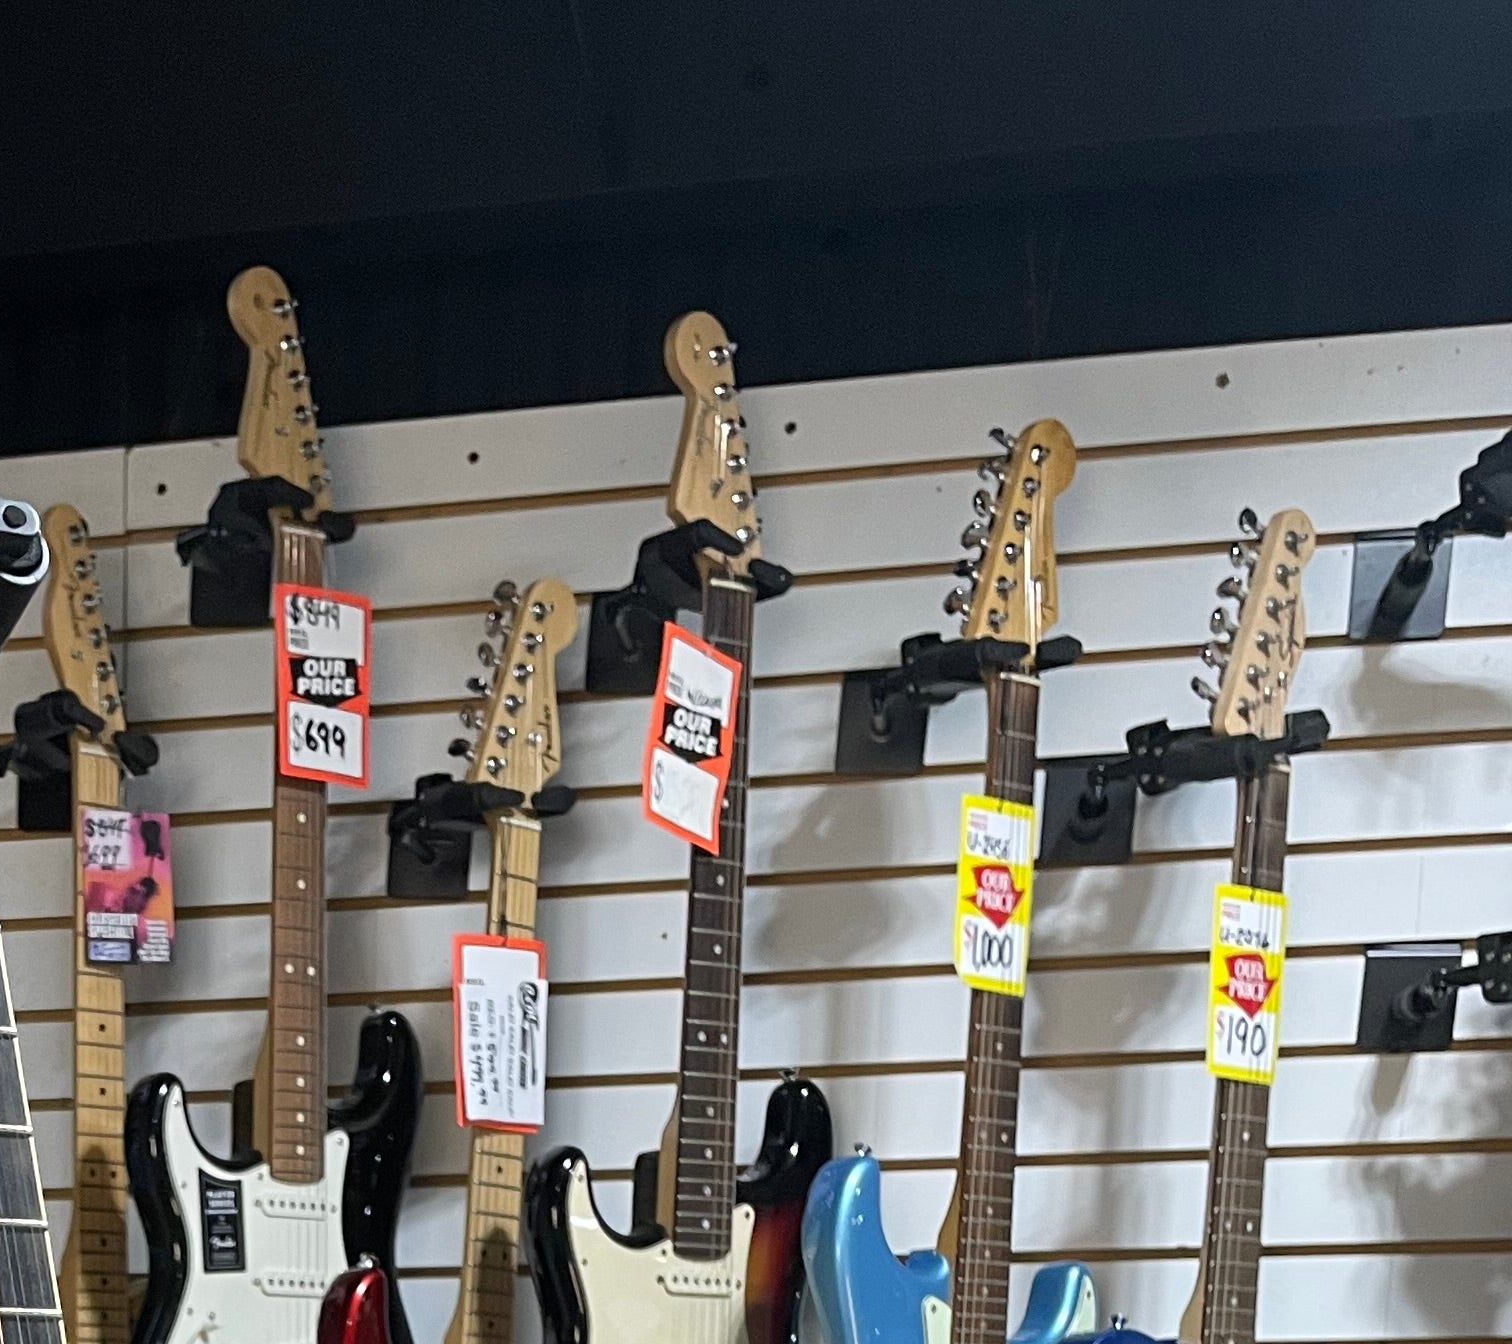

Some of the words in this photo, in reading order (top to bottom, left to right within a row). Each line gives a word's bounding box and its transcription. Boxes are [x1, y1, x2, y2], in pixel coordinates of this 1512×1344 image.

[303, 658, 347, 677] OUR
[297, 677, 356, 696] PRICE
[673, 707, 713, 735] OUR
[292, 711, 346, 761] $699
[664, 725, 719, 757] PRICE
[1234, 957, 1264, 982] OUR
